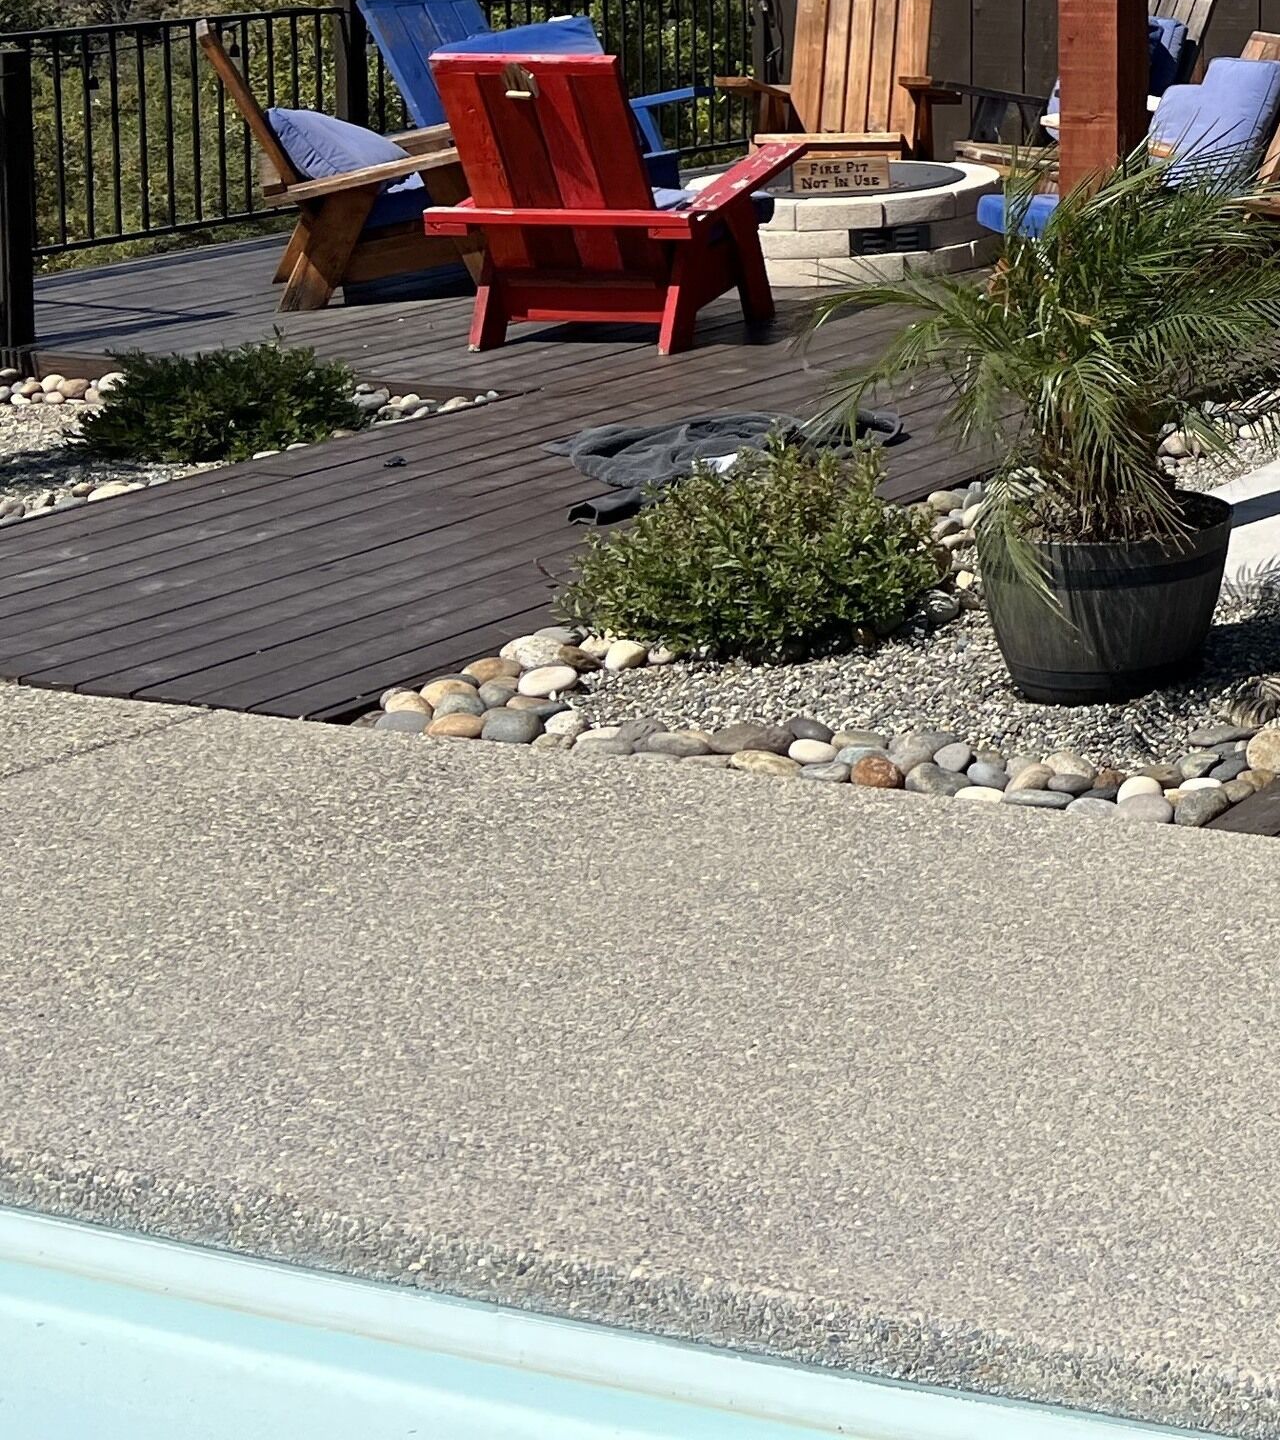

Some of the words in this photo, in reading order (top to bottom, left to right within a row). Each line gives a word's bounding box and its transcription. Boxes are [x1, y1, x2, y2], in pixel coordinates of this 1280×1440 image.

[810, 162, 840, 175] FIRE
[846, 161, 868, 173] PIT
[801, 177, 828, 189] NOT
[834, 176, 848, 188] IN
[854, 174, 880, 186] USE
